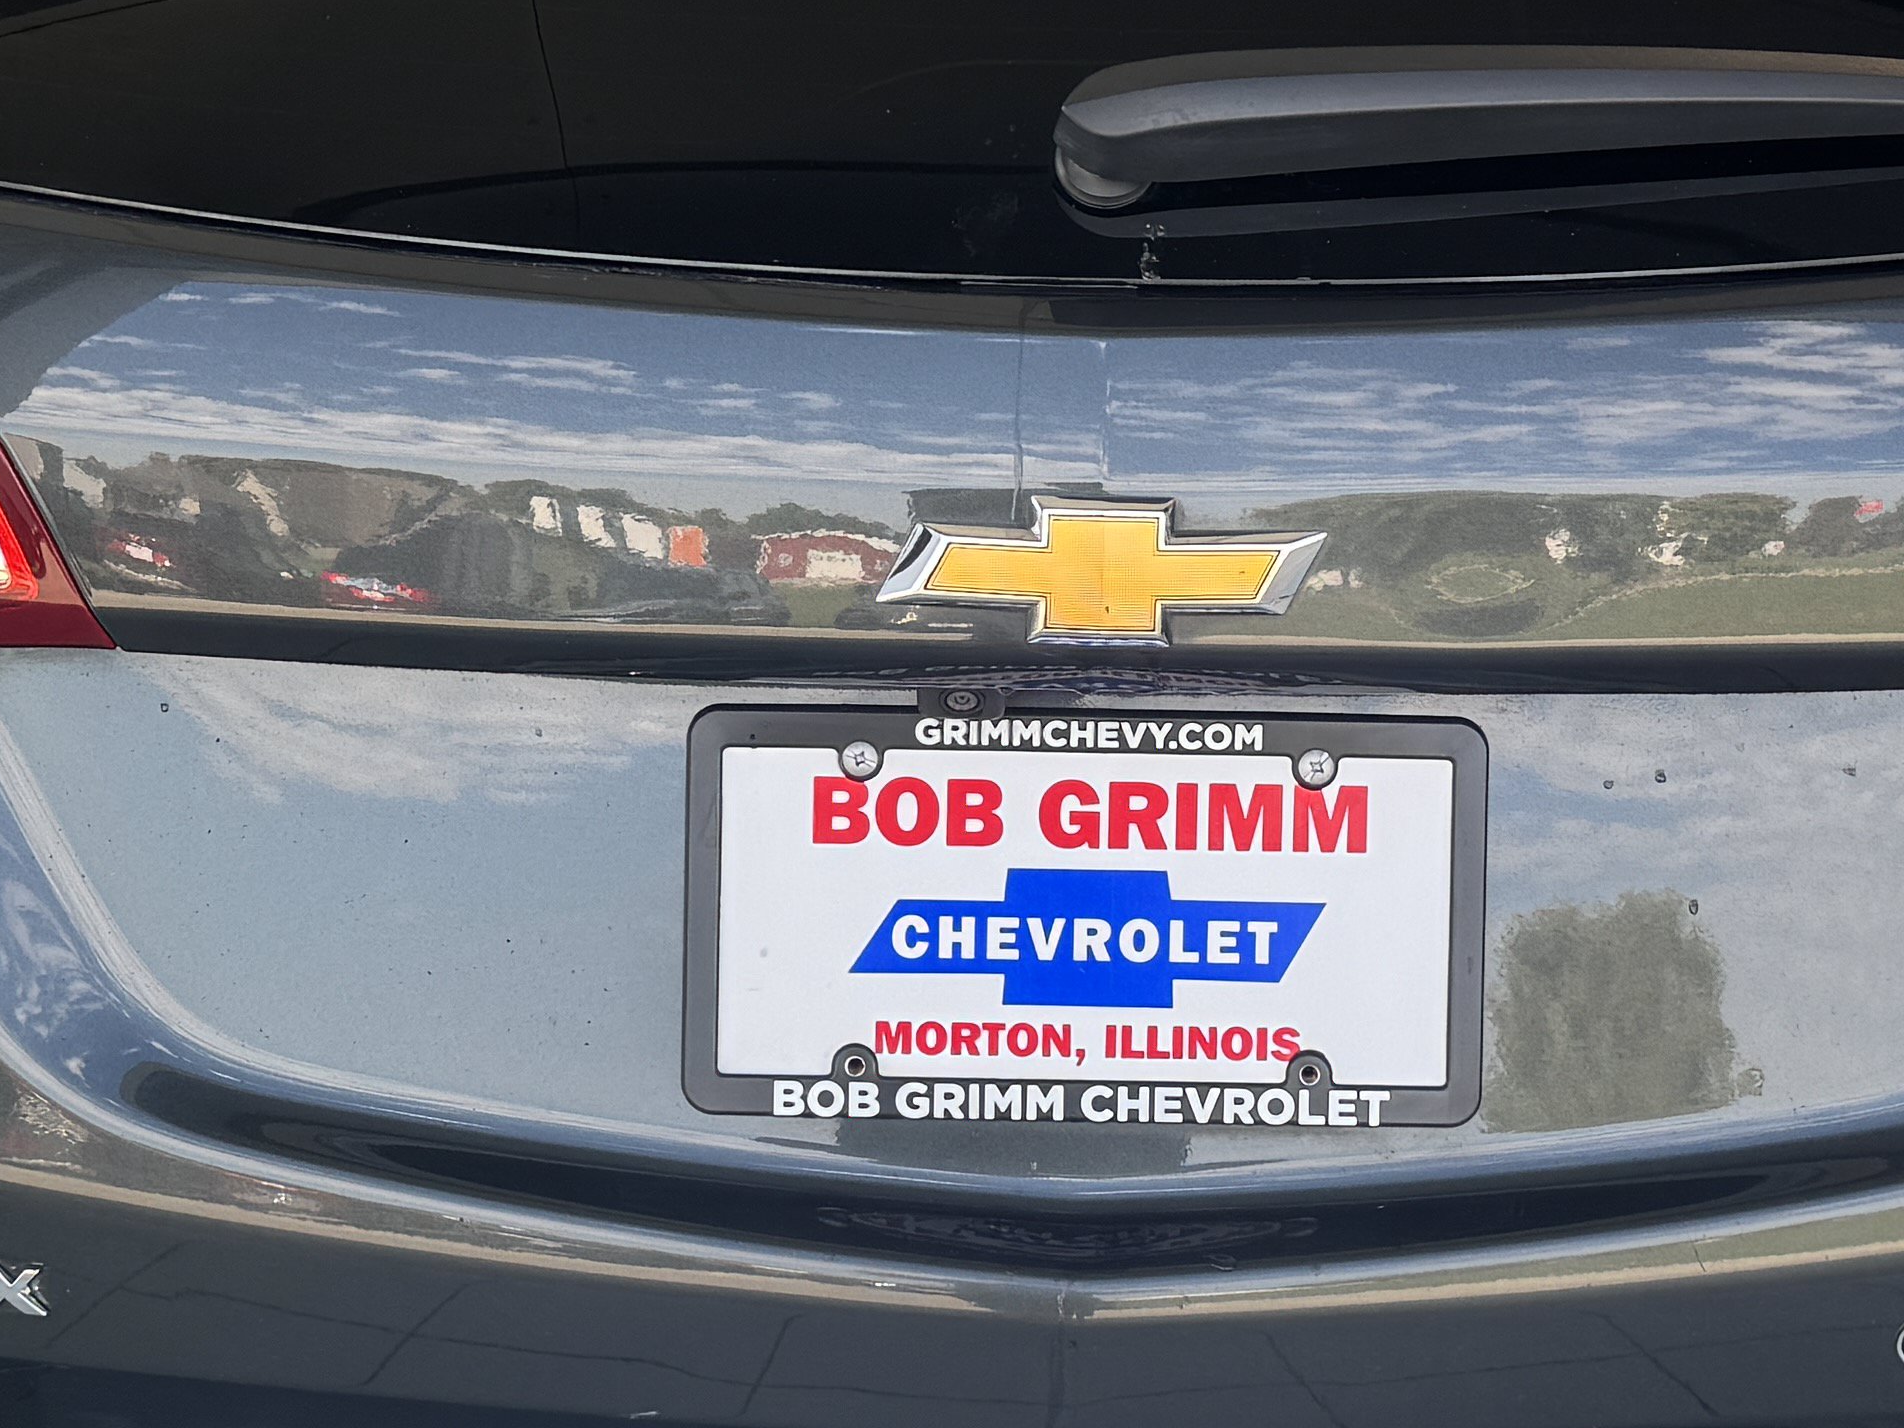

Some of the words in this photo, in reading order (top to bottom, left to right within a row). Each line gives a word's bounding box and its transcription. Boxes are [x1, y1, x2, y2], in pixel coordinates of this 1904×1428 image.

[914, 717, 1264, 752] GRIMMCHEVY.COM
[812, 776, 1004, 847] BOB
[1038, 779, 1369, 854] GRIMM
[891, 914, 1280, 966] CHEVROLET
[874, 1020, 1086, 1067] MORTON,
[1104, 1023, 1301, 1062] ILLINOIS
[772, 1079, 881, 1119] BOB
[894, 1081, 1065, 1122] GRIMM
[1079, 1084, 1391, 1128] CHEVROLET
